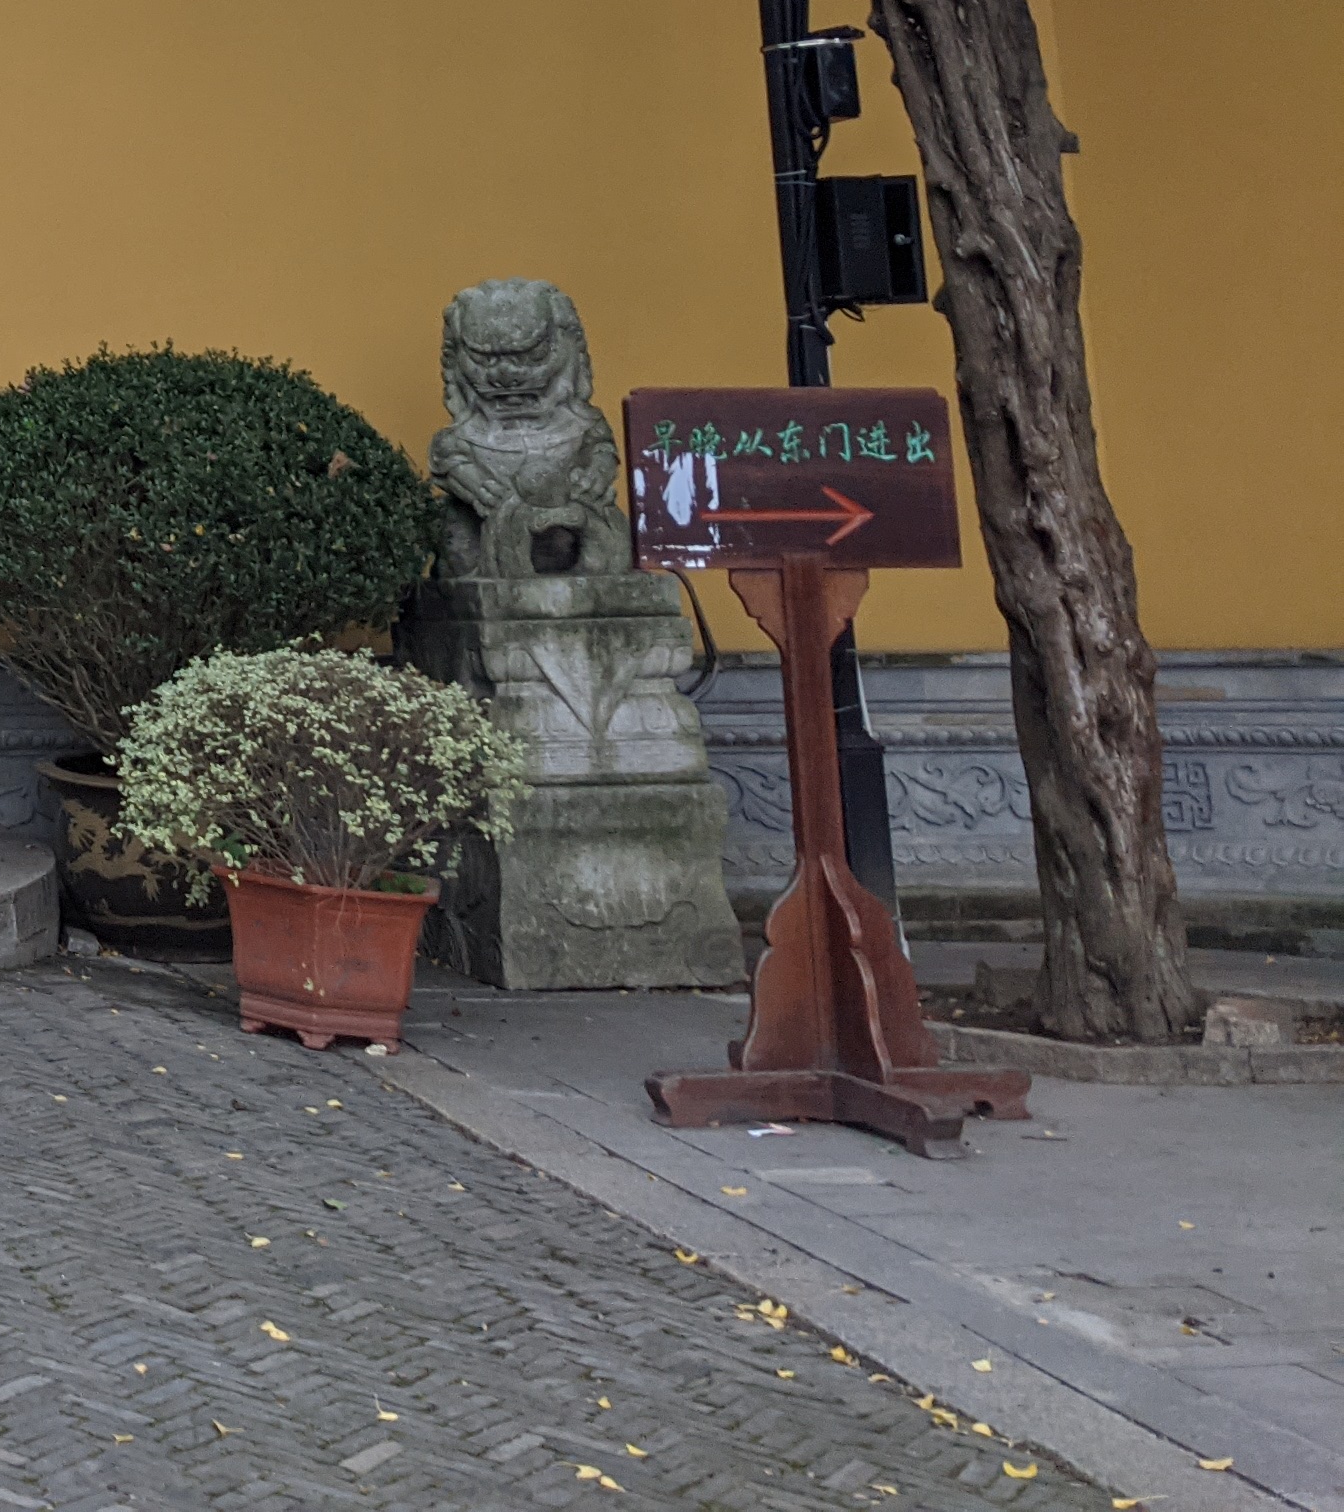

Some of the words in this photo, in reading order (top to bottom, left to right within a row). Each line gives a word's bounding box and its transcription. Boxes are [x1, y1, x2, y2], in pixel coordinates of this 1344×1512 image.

[648, 419, 935, 464] 早晚从东门进出
